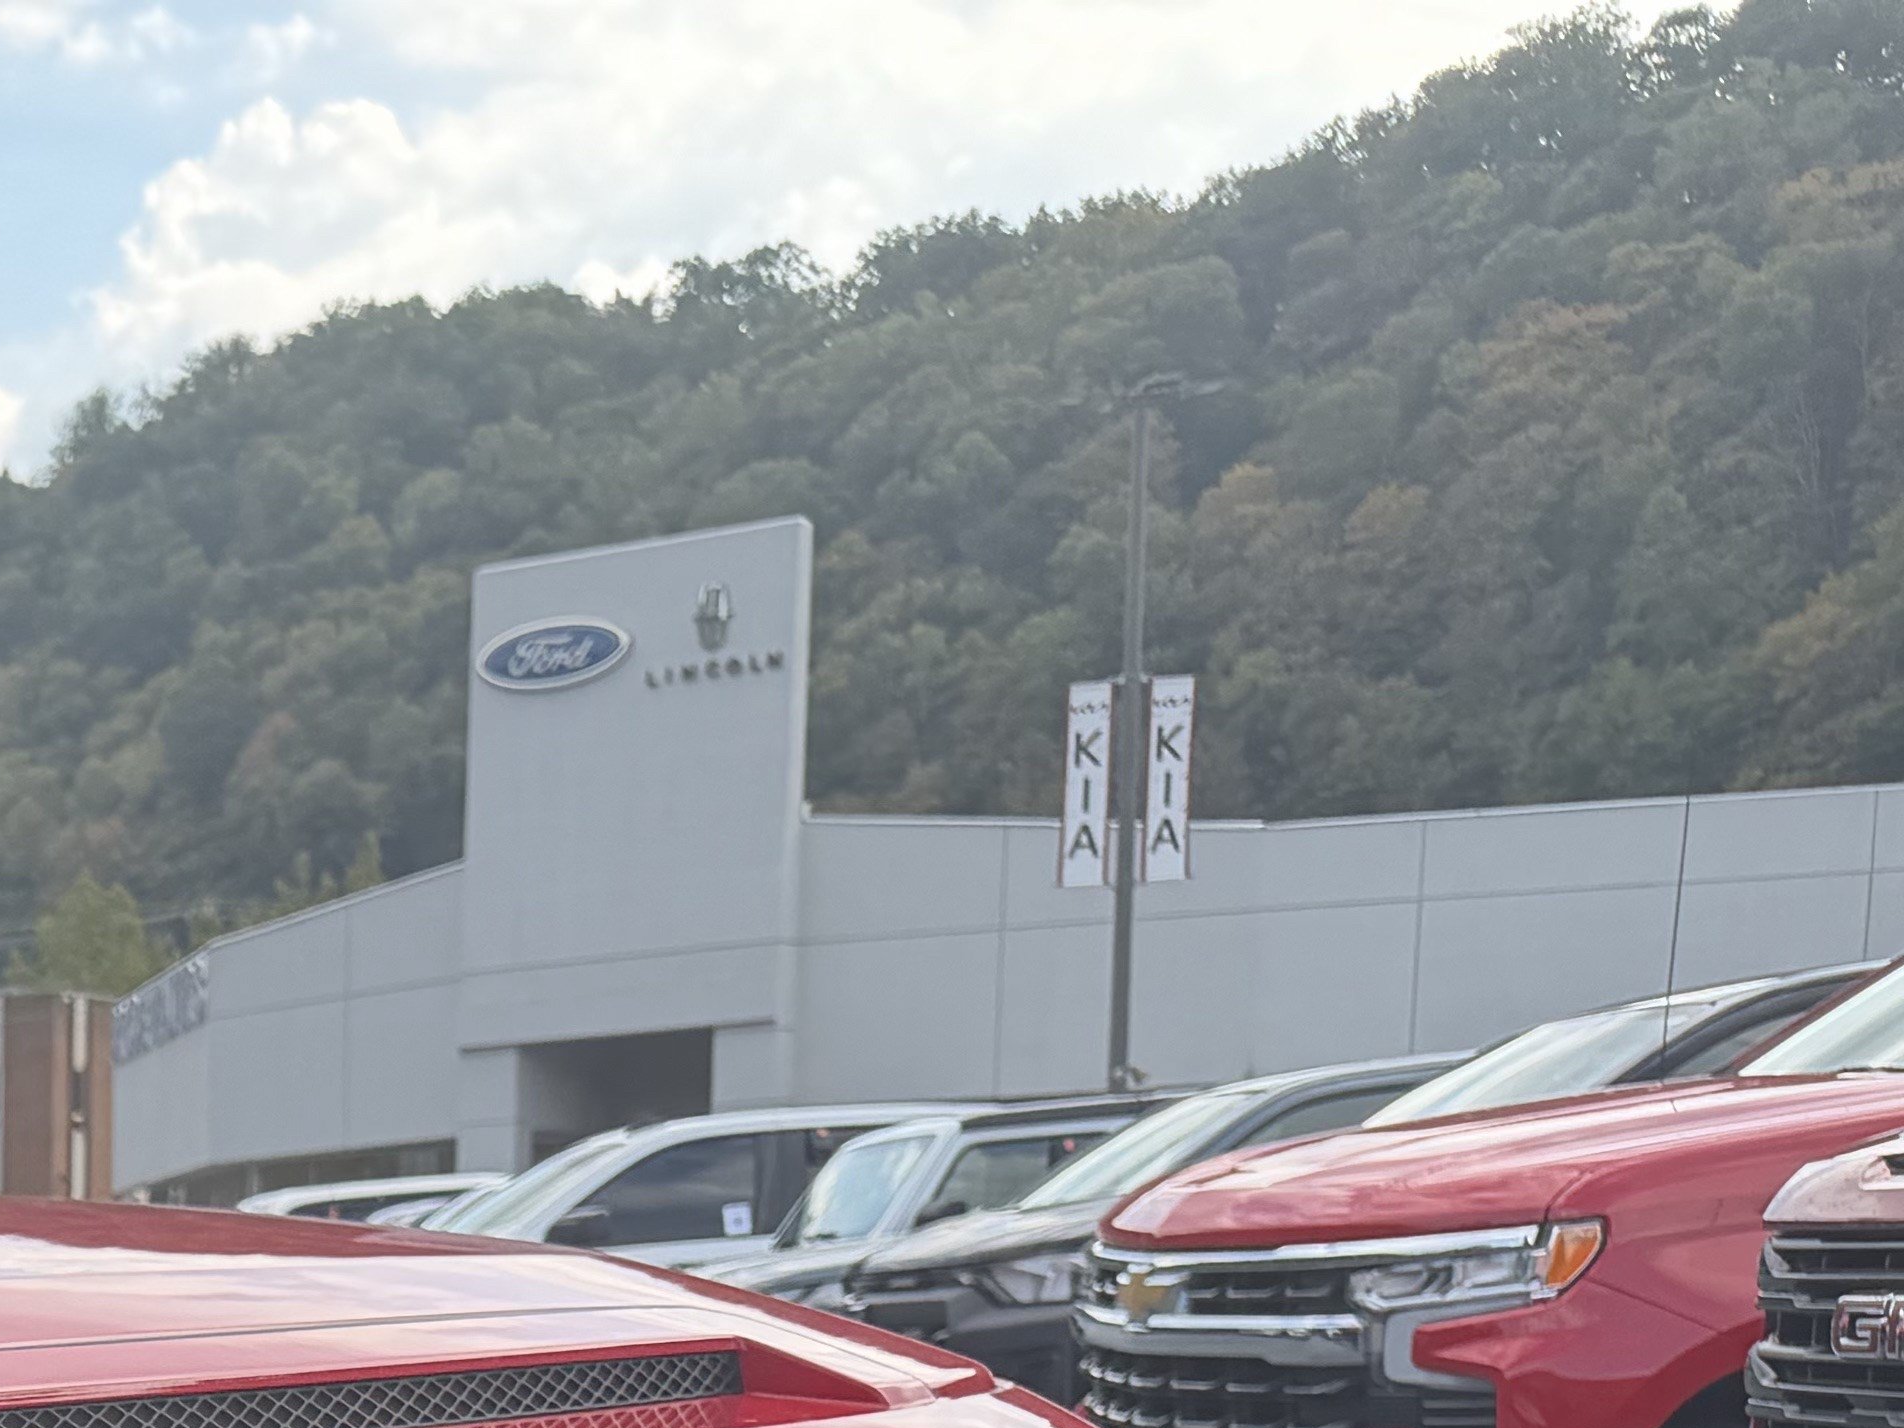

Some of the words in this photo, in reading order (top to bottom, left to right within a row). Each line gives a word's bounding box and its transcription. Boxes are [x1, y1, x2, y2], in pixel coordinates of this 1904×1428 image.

[508, 634, 594, 677] Ford
[645, 652, 785, 690] LINCOLN
[1068, 730, 1104, 859] KIA
[1151, 724, 1185, 855] KIA
